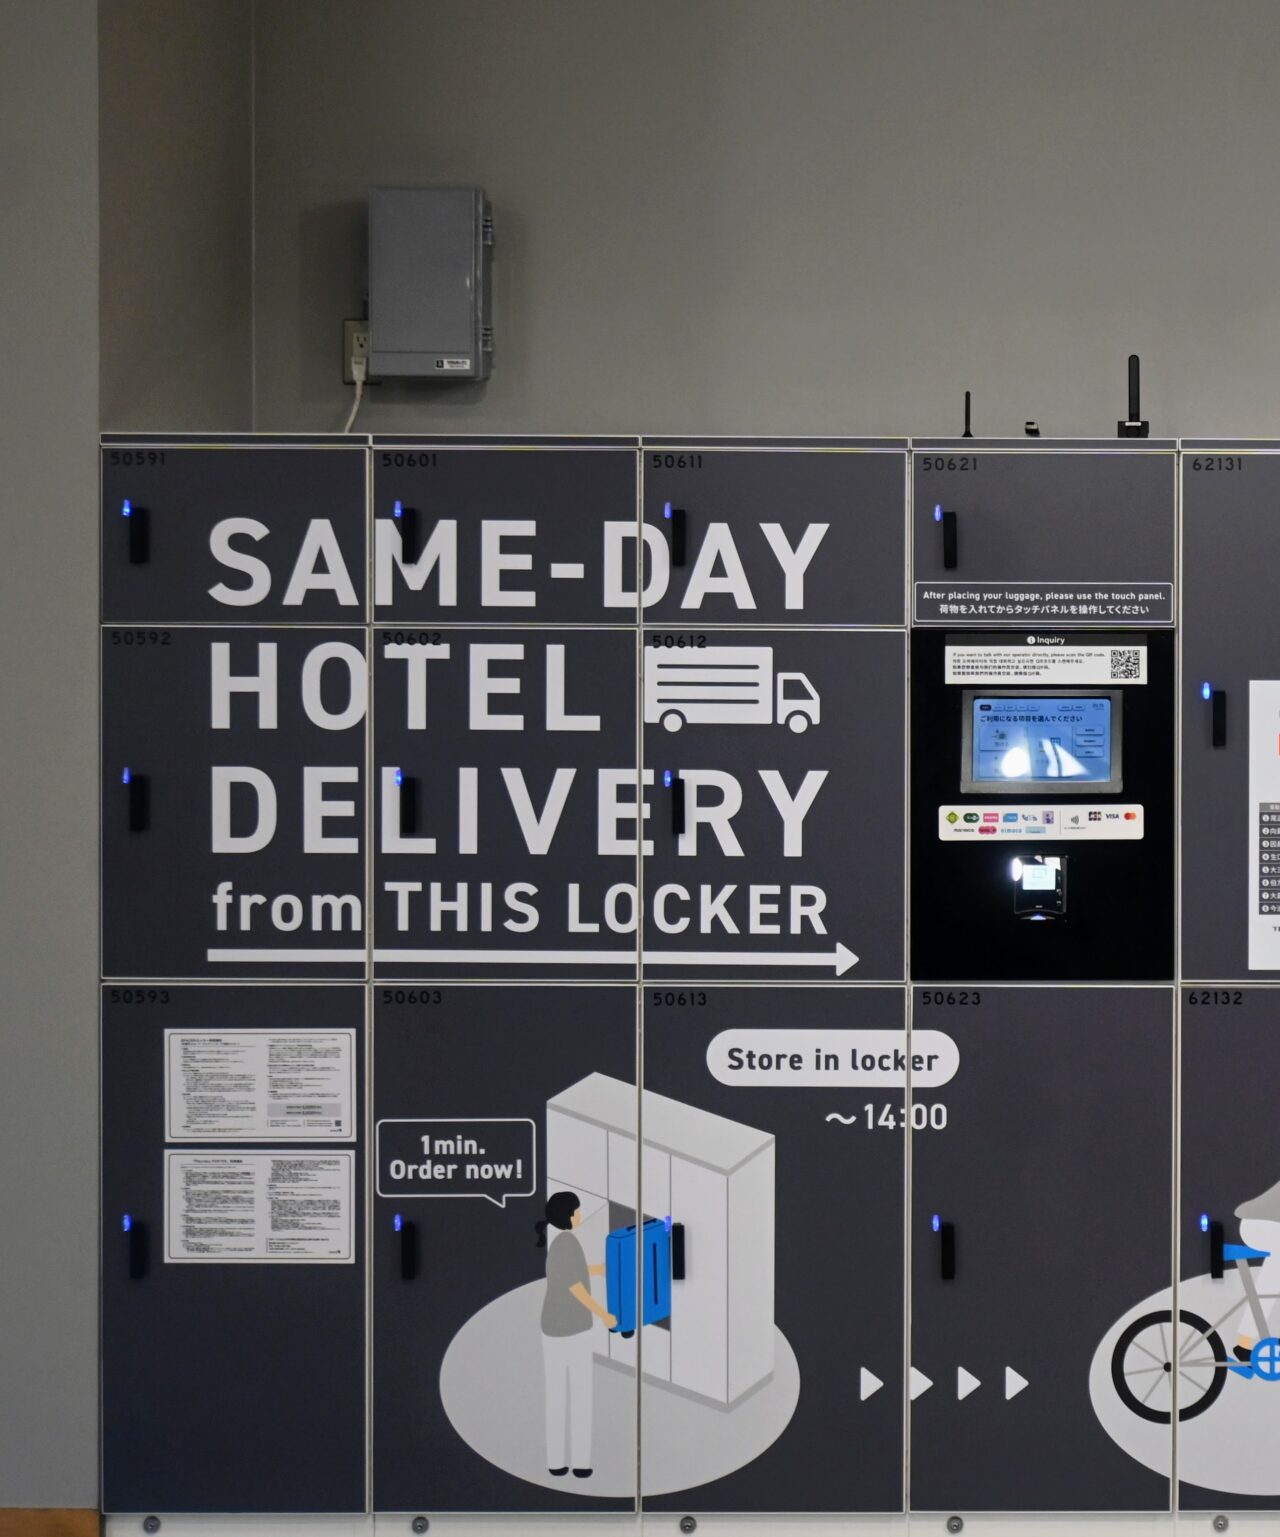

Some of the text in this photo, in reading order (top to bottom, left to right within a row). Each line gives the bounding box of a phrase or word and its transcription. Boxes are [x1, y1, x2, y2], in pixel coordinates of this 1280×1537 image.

[111, 452, 166, 466] 50591
[382, 453, 438, 467] 50601
[652, 454, 704, 469] 50611
[923, 457, 976, 471] 50621
[1193, 457, 1241, 471] 62131
[207, 517, 830, 610] SAME-DAY
[923, 590, 1166, 602] After placing your luggage, please use the touch panel.
[940, 604, 1149, 614] 荷物を入れてからタッチパネルを操作してください
[112, 630, 171, 646] 50592
[381, 630, 442, 647] 50602
[652, 633, 708, 648] 50612
[1036, 635, 1065, 647] Inquiry
[210, 641, 601, 732] HOTEL
[979, 713, 1083, 724] ご利用になる項目を選んでください
[211, 766, 830, 857] DELIVERY
[211, 880, 830, 936] from THIS LOCKER
[110, 989, 170, 1004] 50593
[384, 990, 442, 1004] 50603
[654, 992, 707, 1006] 50613
[923, 992, 980, 1005] 50623
[1189, 991, 1242, 1005] 62132
[728, 1046, 939, 1073] Store in locker
[421, 1135, 485, 1154] 1min.
[390, 1159, 522, 1179] Order now!
